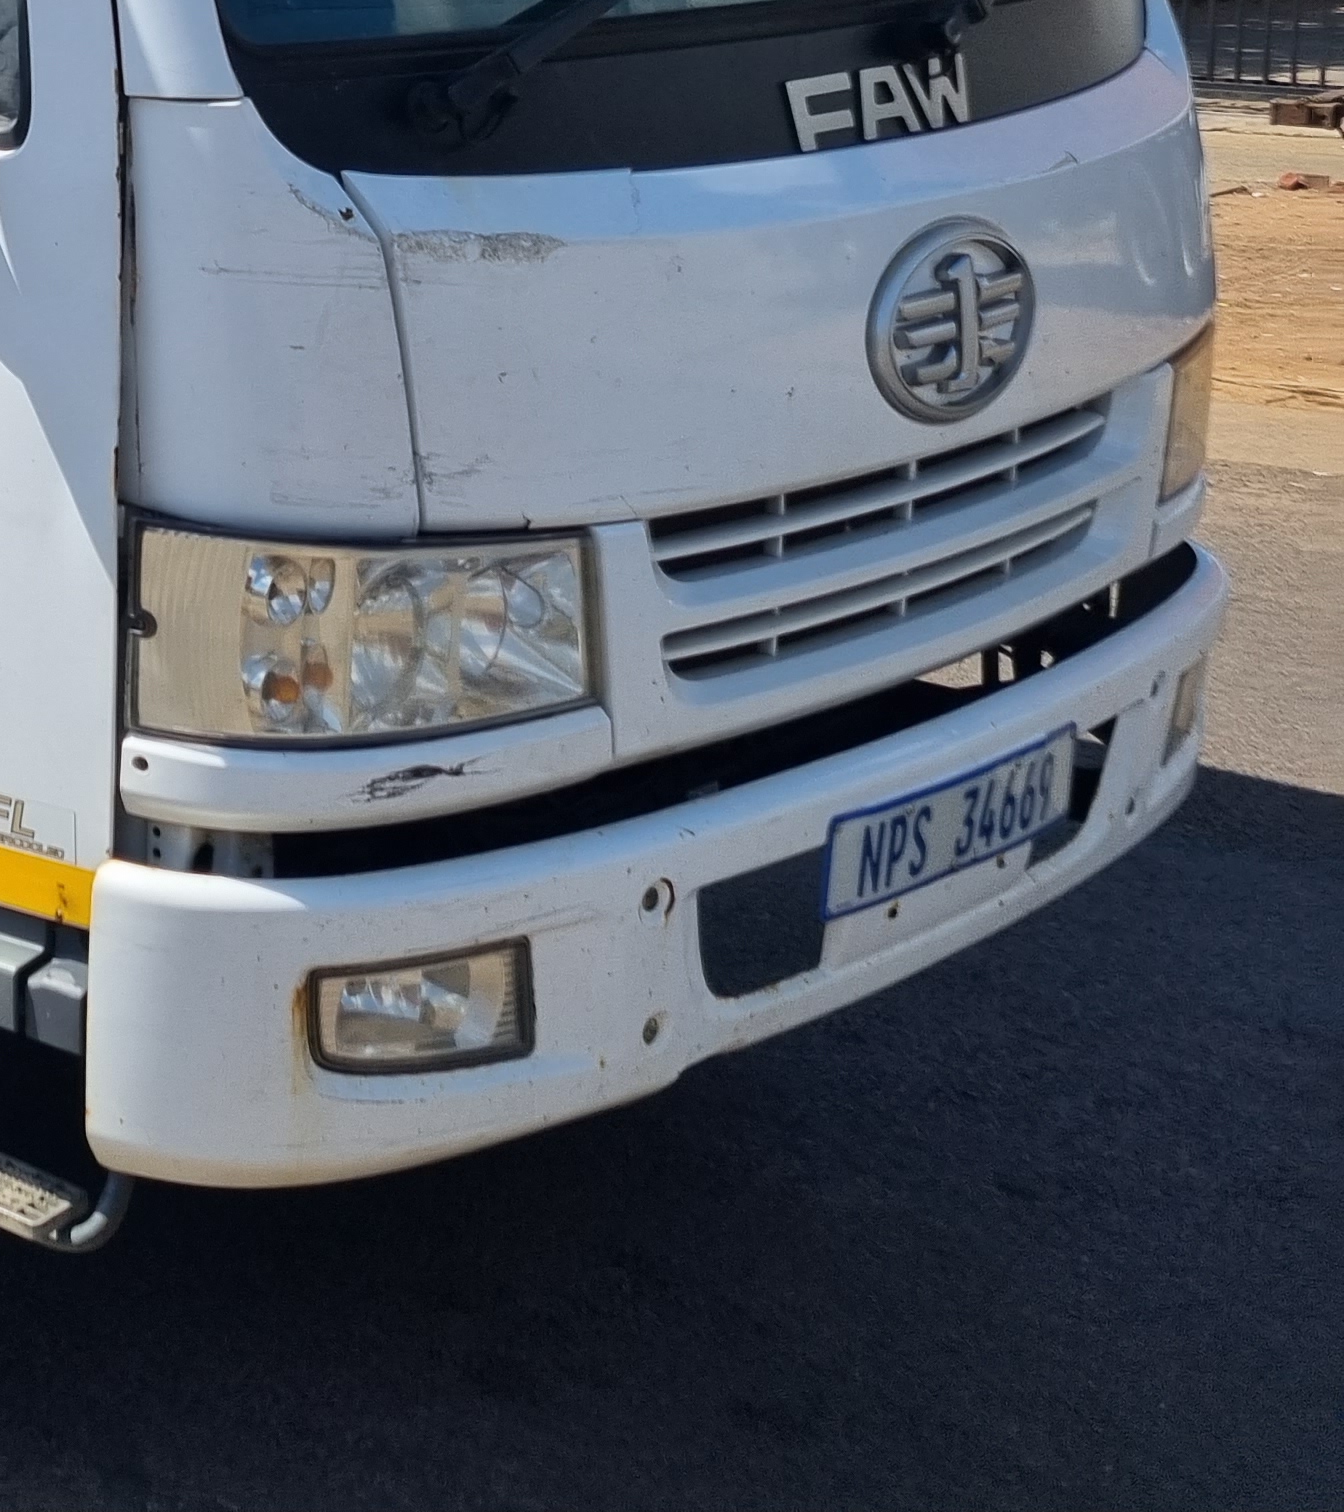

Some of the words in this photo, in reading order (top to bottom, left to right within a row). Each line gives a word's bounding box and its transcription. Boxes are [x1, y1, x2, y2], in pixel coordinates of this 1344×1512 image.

[785, 53, 970, 153] FAW
[857, 806, 932, 897] NPS
[955, 752, 1055, 857] 34669
